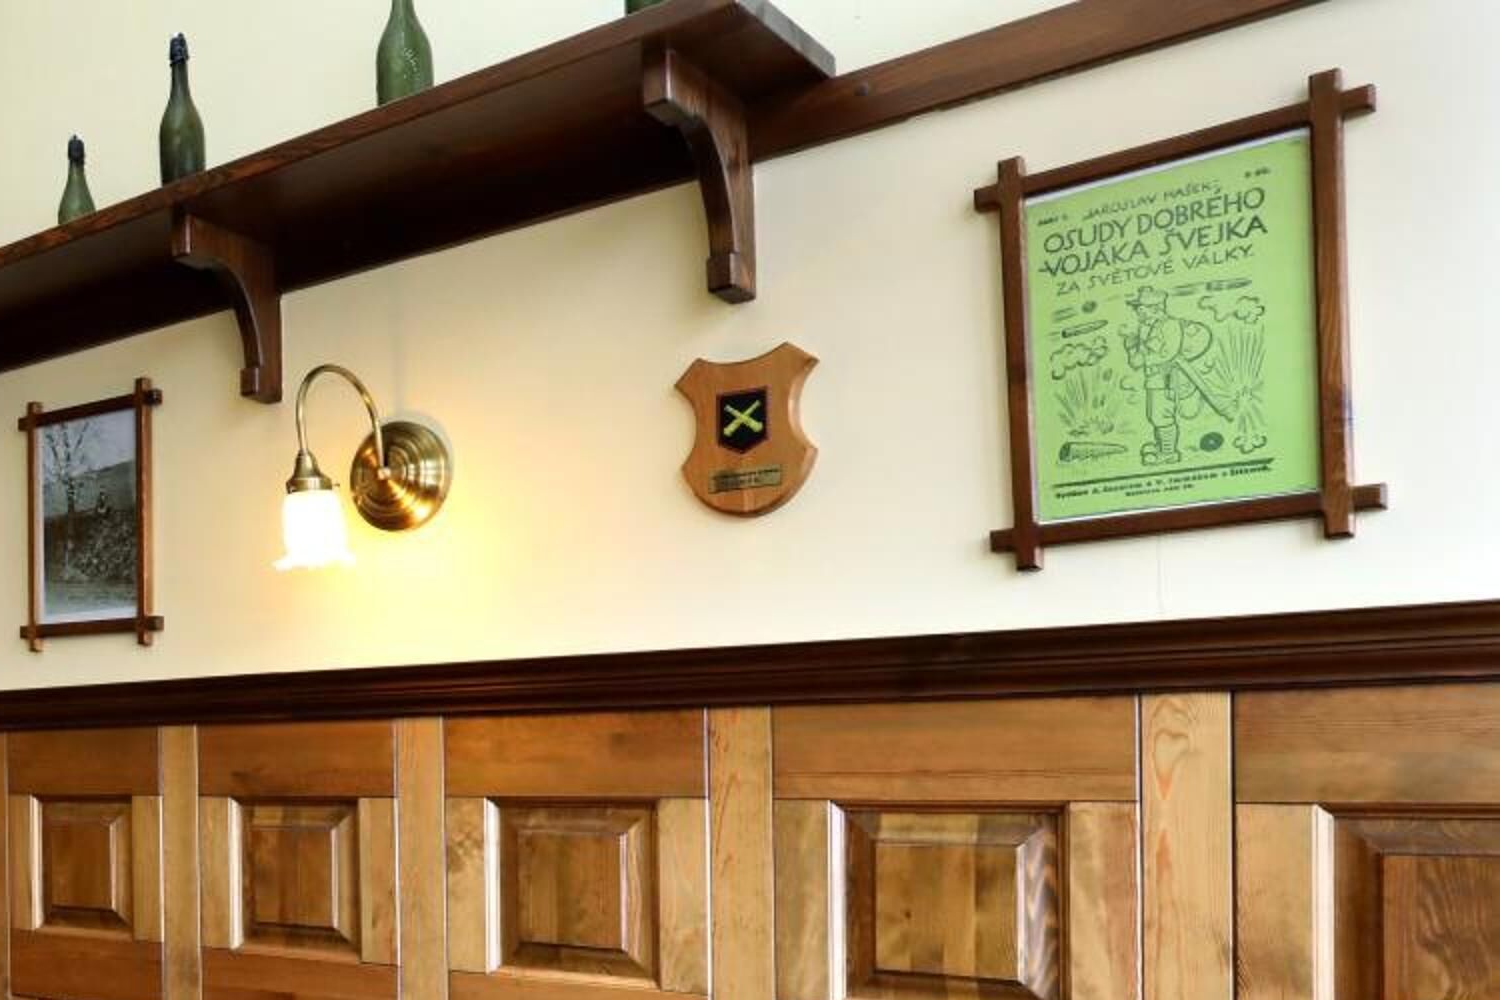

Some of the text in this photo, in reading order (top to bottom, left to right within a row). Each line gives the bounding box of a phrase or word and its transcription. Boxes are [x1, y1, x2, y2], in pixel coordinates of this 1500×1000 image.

[1038, 215, 1268, 277] VOJÁKA ŠVEJKA
[1043, 187, 1265, 253] OSUDY DOBRÉHO
[1057, 281, 1080, 296] ZA
